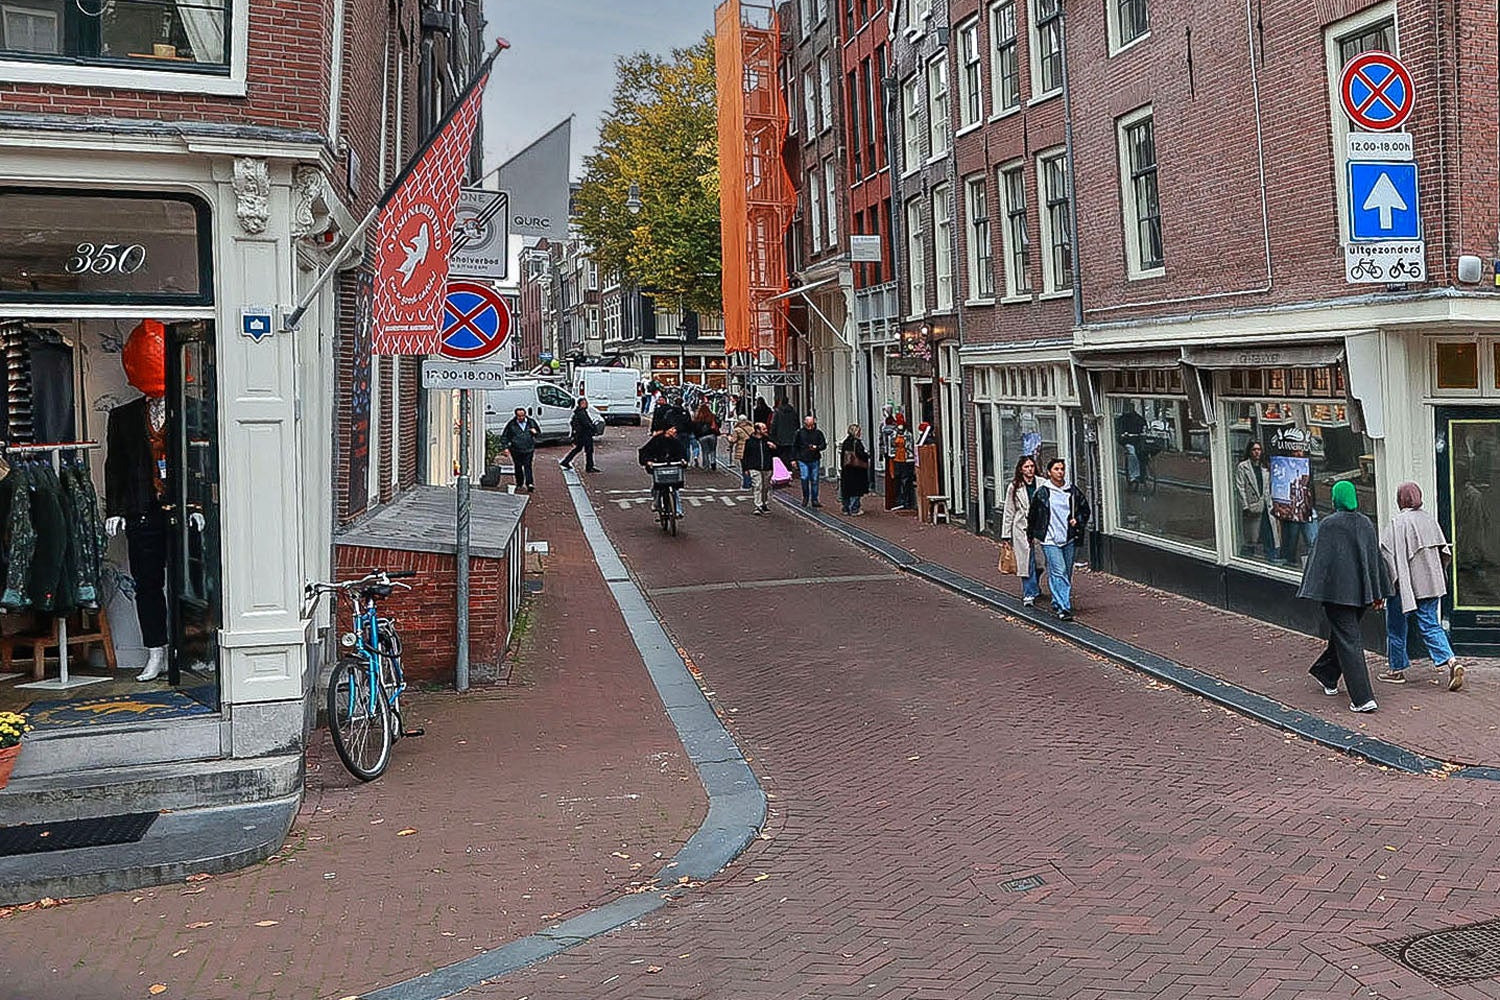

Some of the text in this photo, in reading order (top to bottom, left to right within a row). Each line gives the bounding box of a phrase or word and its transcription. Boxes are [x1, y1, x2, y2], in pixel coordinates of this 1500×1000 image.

[1351, 142, 1410, 151] 12.00-18.00h
[460, 193, 486, 203] ONE
[1350, 245, 1420, 256] uitgezonderd
[64, 242, 146, 275] 350
